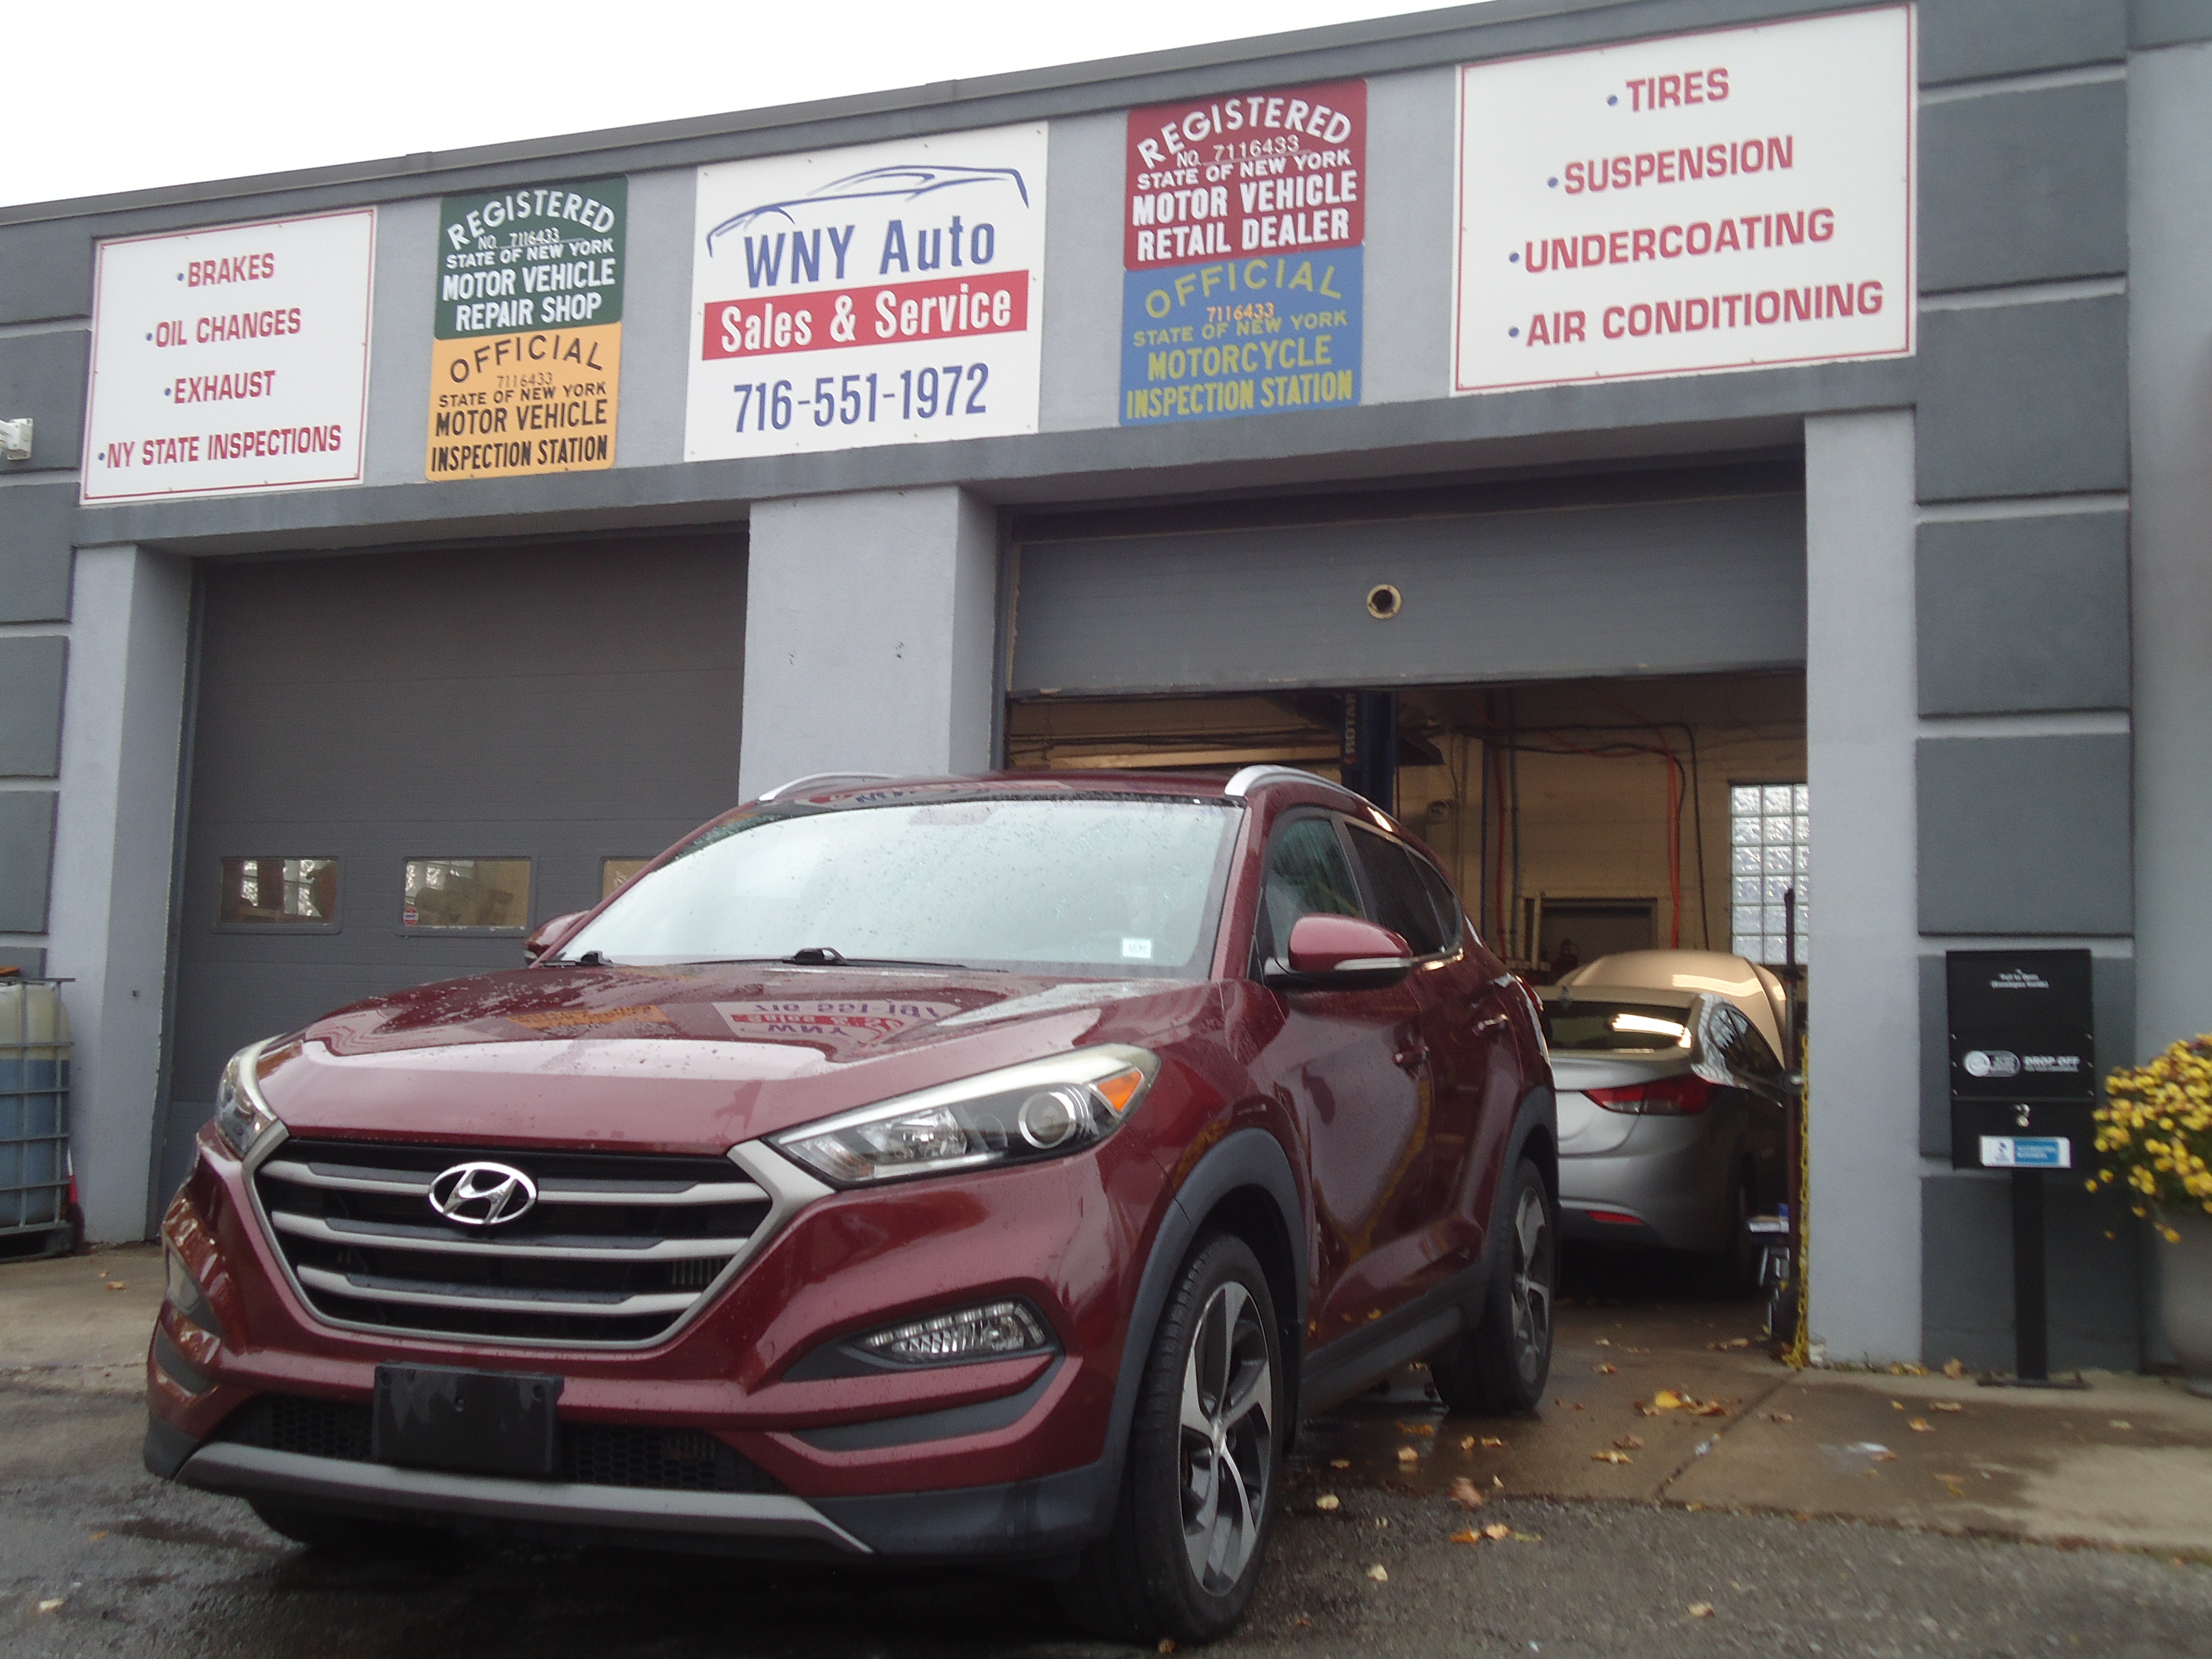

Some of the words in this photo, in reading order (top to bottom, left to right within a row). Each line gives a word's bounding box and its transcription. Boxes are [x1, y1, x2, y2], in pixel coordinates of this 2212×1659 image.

[1625, 67, 1730, 112] TIRES
[1137, 96, 1352, 169] REGISTERED
[1213, 134, 1300, 161] 7116433
[1137, 169, 1199, 190] STATE
[1205, 163, 1234, 182] OF
[1240, 158, 1287, 179] NEW
[1293, 148, 1352, 172] YORK
[1564, 135, 1794, 195] SUSPENSION
[446, 189, 614, 251] REGISTERED
[1132, 186, 1228, 226] MOTOR
[1240, 169, 1357, 214] VEHICLE
[446, 252, 495, 269] STATE
[500, 247, 521, 263] OF
[527, 245, 564, 260] NEW
[569, 238, 614, 256] YORK
[509, 227, 560, 246] 7116433
[744, 224, 856, 288] WNY
[879, 215, 995, 275] Auto
[1137, 221, 1231, 262] RETAIL
[1242, 208, 1350, 251] DEALER
[1525, 207, 1835, 273] UNDERCOATING
[187, 252, 274, 287] BRAKES
[442, 268, 516, 301] MOTOR
[522, 258, 616, 293] VEHICLE
[1145, 258, 1343, 318] OFFICIAL
[155, 321, 187, 348] OIL
[196, 308, 301, 344] CHANGES
[456, 298, 535, 331] REPAIR
[541, 292, 603, 323] SHOP
[720, 303, 813, 353] Sales
[830, 294, 857, 343] &
[874, 283, 1011, 339] Service
[1133, 324, 1194, 347] STATE
[1202, 321, 1227, 340] OF
[1236, 316, 1281, 337] NEW
[1290, 309, 1348, 330] YORK
[1206, 302, 1275, 323] 7116433
[1526, 310, 1586, 347] AIR
[1602, 280, 1883, 339] CONDITIONING
[450, 334, 603, 383] OFFICIAL
[1148, 334, 1332, 381] MOTORCYCLE
[174, 370, 275, 404] EXHAUST
[439, 393, 486, 408] STATE
[493, 390, 514, 403] OF
[520, 387, 556, 401] NEW
[563, 382, 606, 397] YORK
[497, 373, 554, 388] 7116433
[734, 363, 989, 433] 716-551-1972
[1128, 378, 1255, 419] INSPECTION
[1261, 369, 1353, 409] STATION
[436, 408, 507, 437] MOTOR
[516, 399, 607, 431] VEHICLE
[107, 441, 135, 469] NY
[142, 436, 199, 465] STATE
[207, 424, 341, 460] INSPECTIONS
[431, 440, 531, 472] INSPECTION
[537, 435, 608, 466] STATION
